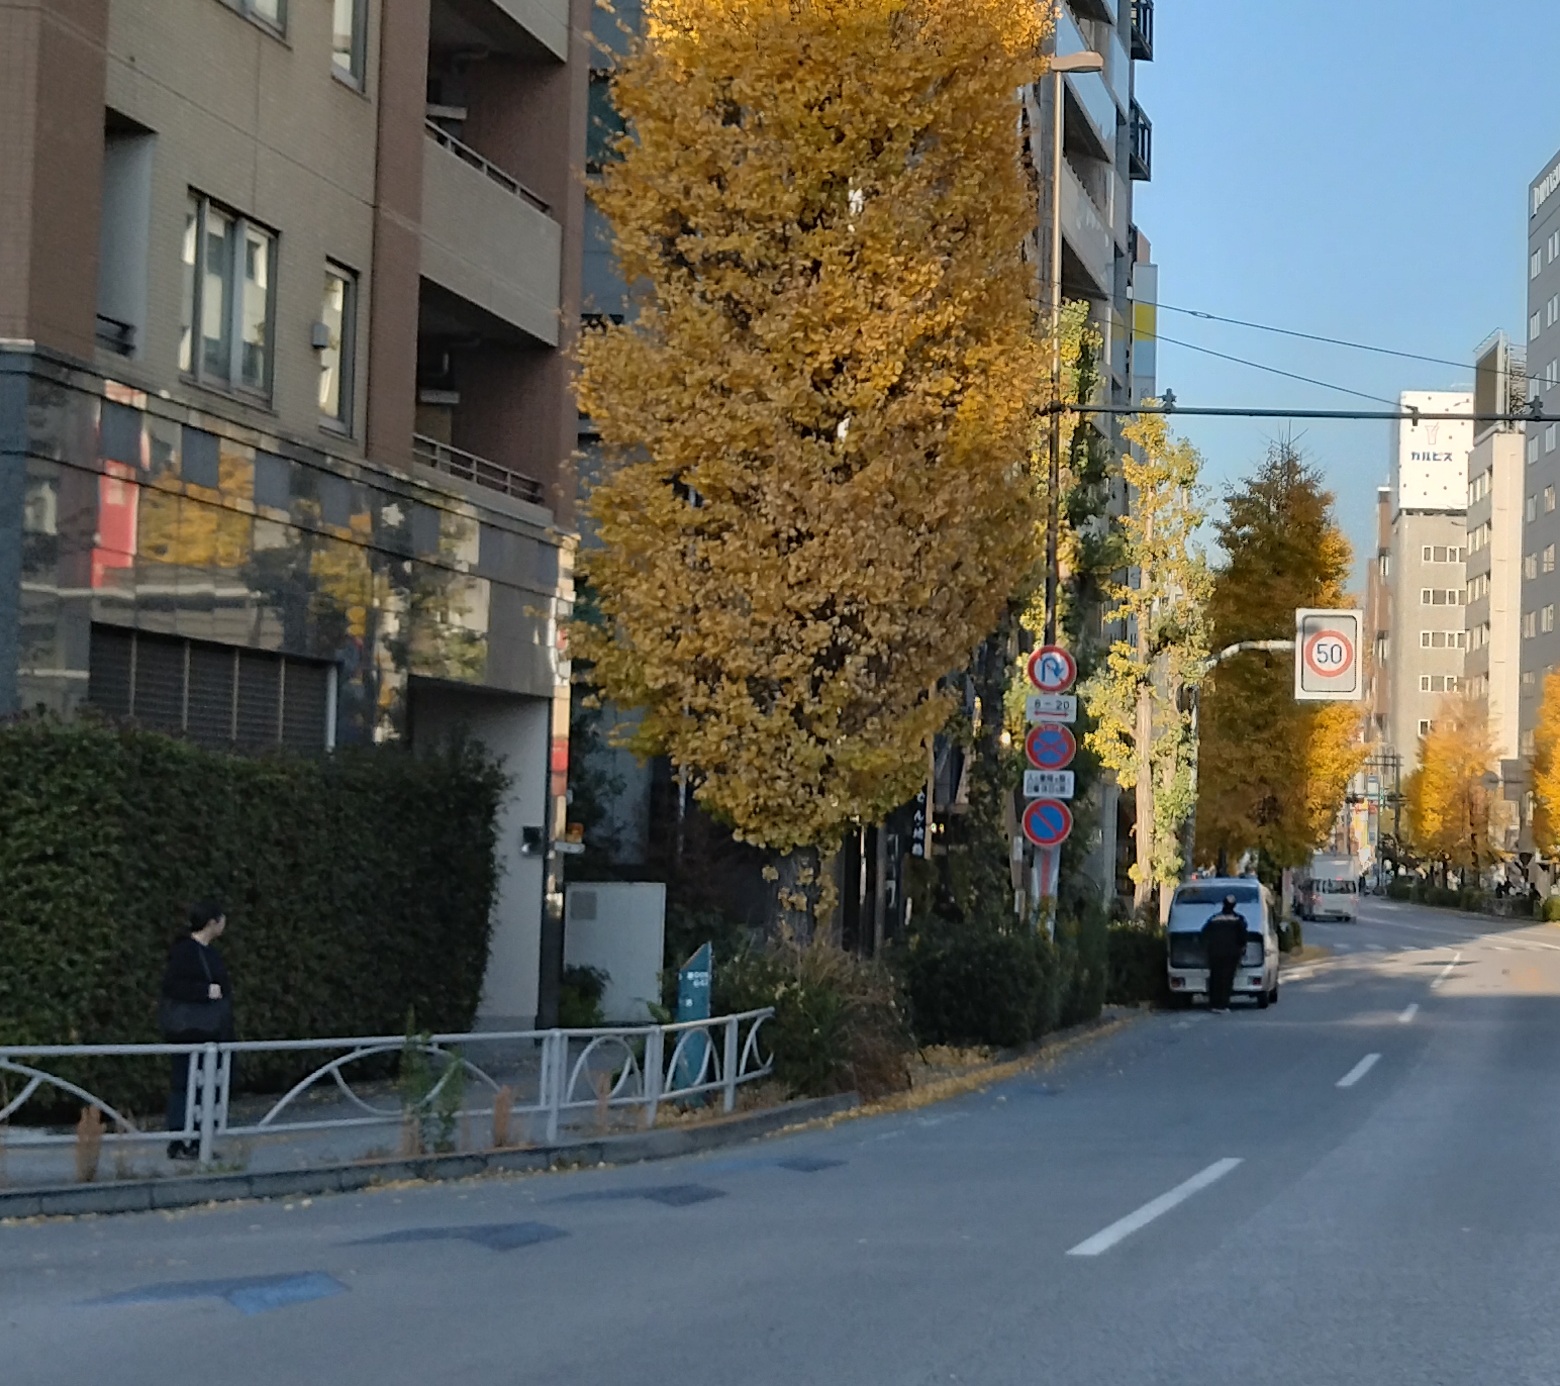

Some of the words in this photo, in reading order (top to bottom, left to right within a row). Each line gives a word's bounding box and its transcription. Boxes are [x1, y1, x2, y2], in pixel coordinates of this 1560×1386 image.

[1411, 451, 1453, 462] カルピス
[1316, 643, 1343, 665] 50
